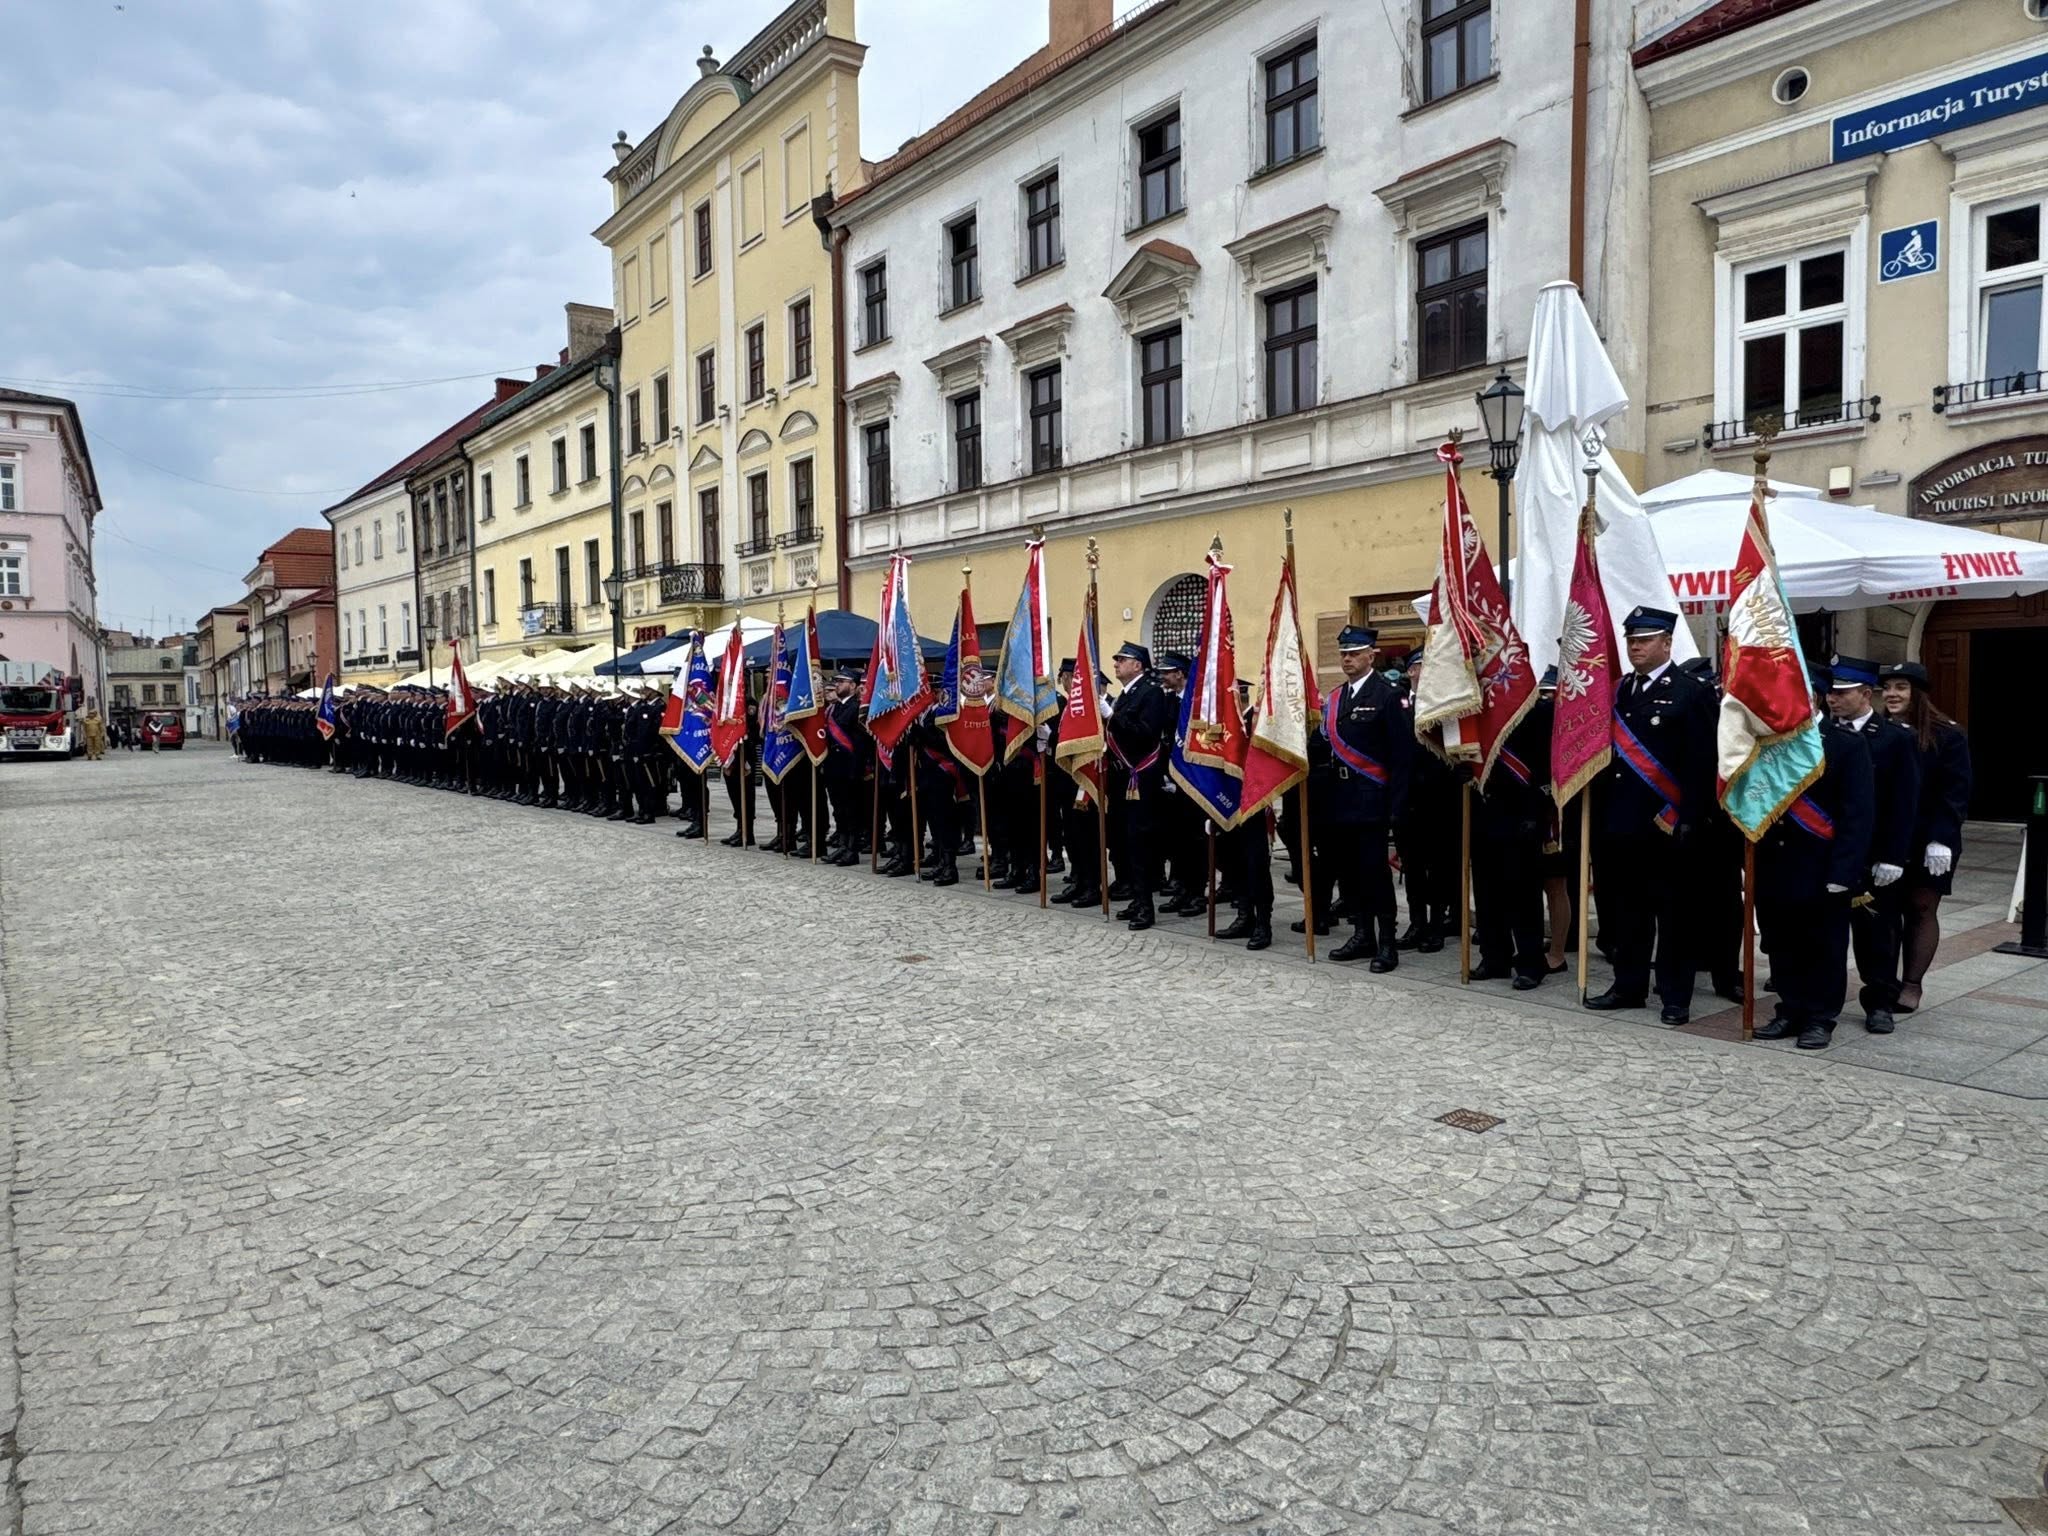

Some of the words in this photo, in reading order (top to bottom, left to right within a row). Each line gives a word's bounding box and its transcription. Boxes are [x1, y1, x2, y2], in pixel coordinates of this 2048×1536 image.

[1842, 97, 1965, 147] Informacja
[1920, 455, 2016, 504] INFORMACJA
[1933, 495, 1995, 513] TOURIST
[1941, 551, 2023, 580] ŻYWIEC
[1668, 569, 1736, 597] YWI
